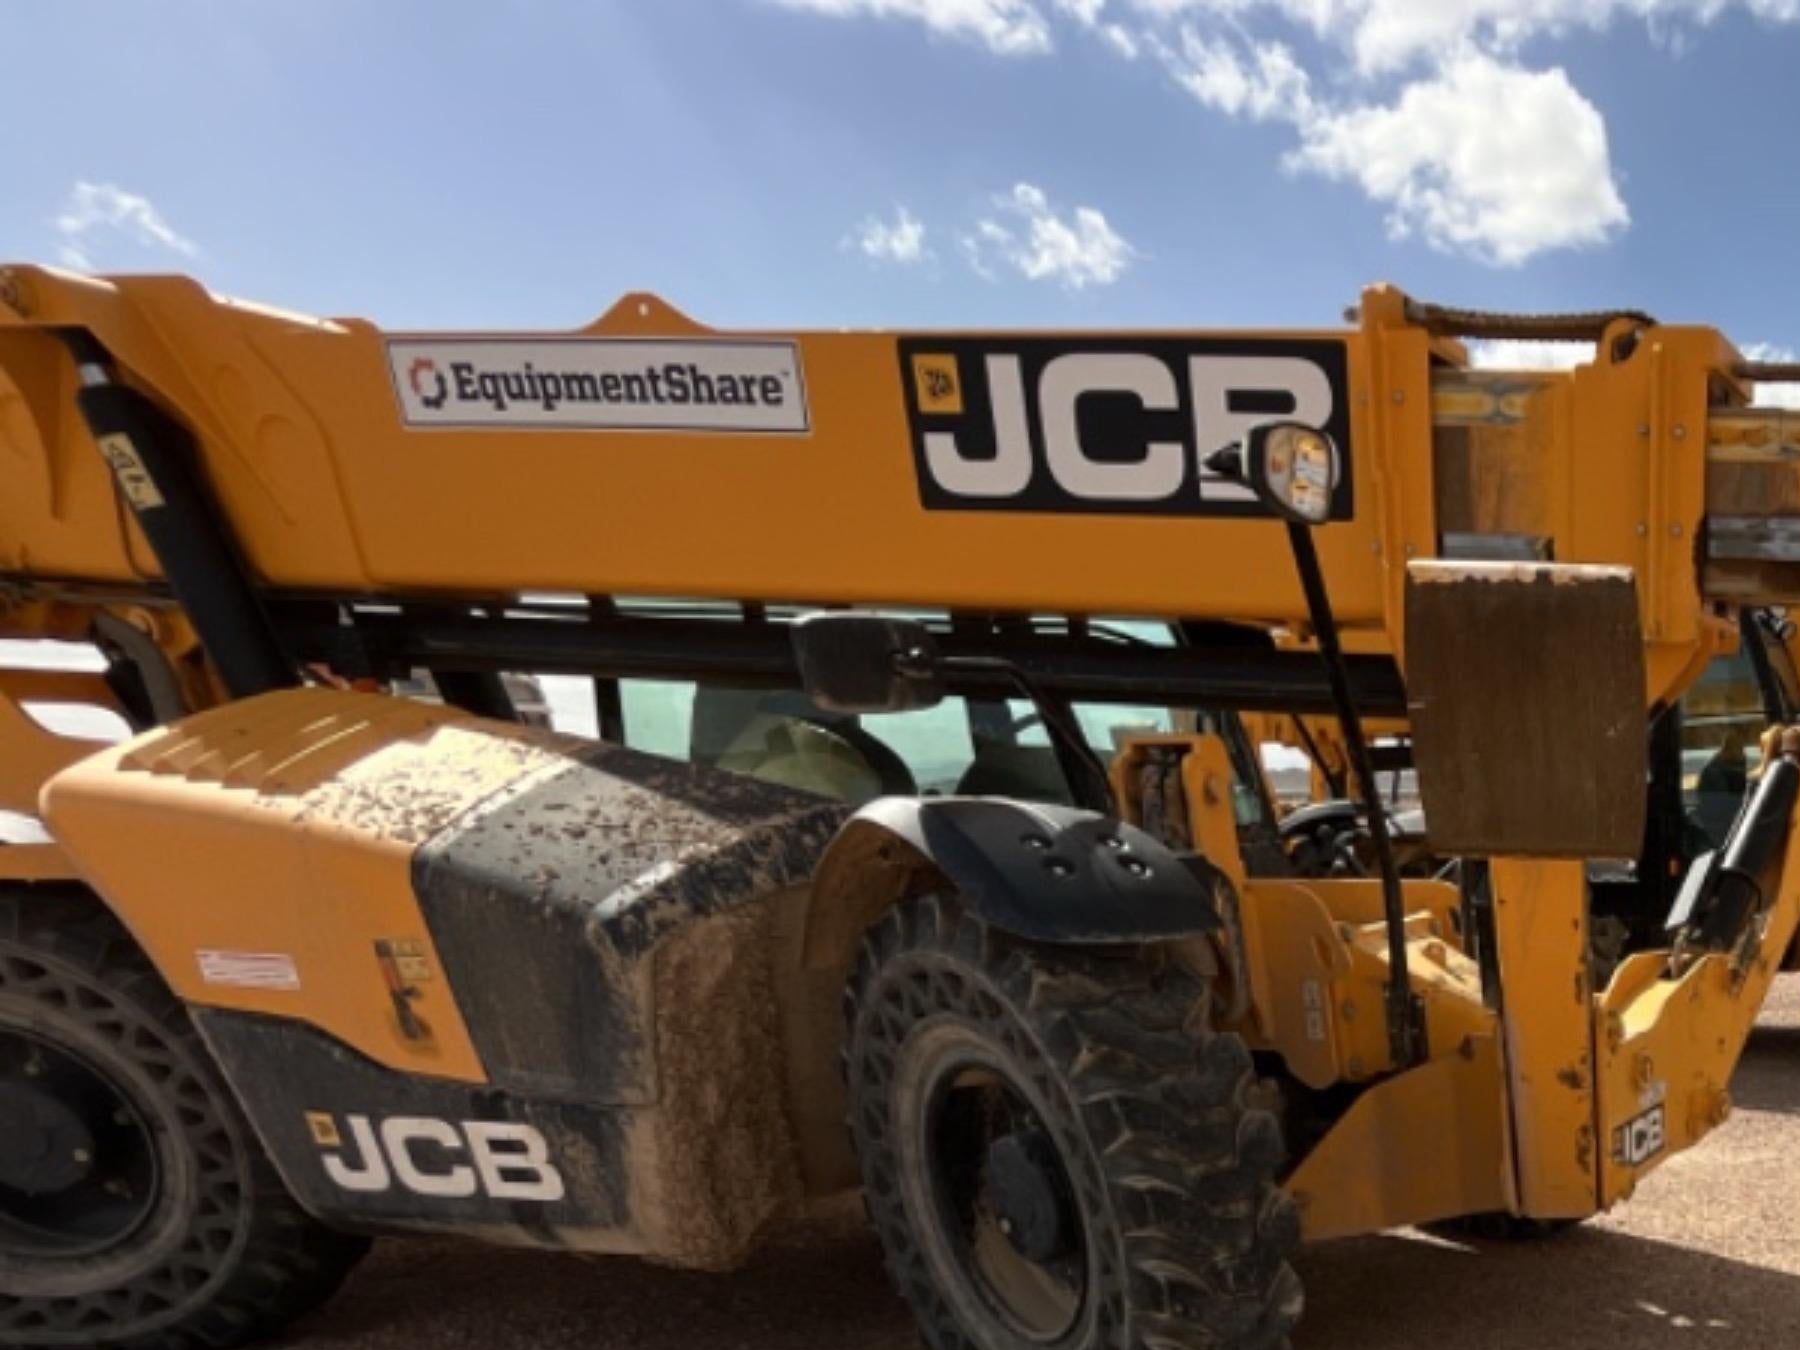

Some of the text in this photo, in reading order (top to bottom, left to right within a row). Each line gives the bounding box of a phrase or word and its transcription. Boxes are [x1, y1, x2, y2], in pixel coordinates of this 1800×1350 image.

[449, 362, 785, 411] EquipmentShare
[923, 352, 1341, 502] JCB
[321, 1114, 565, 1201] JCB
